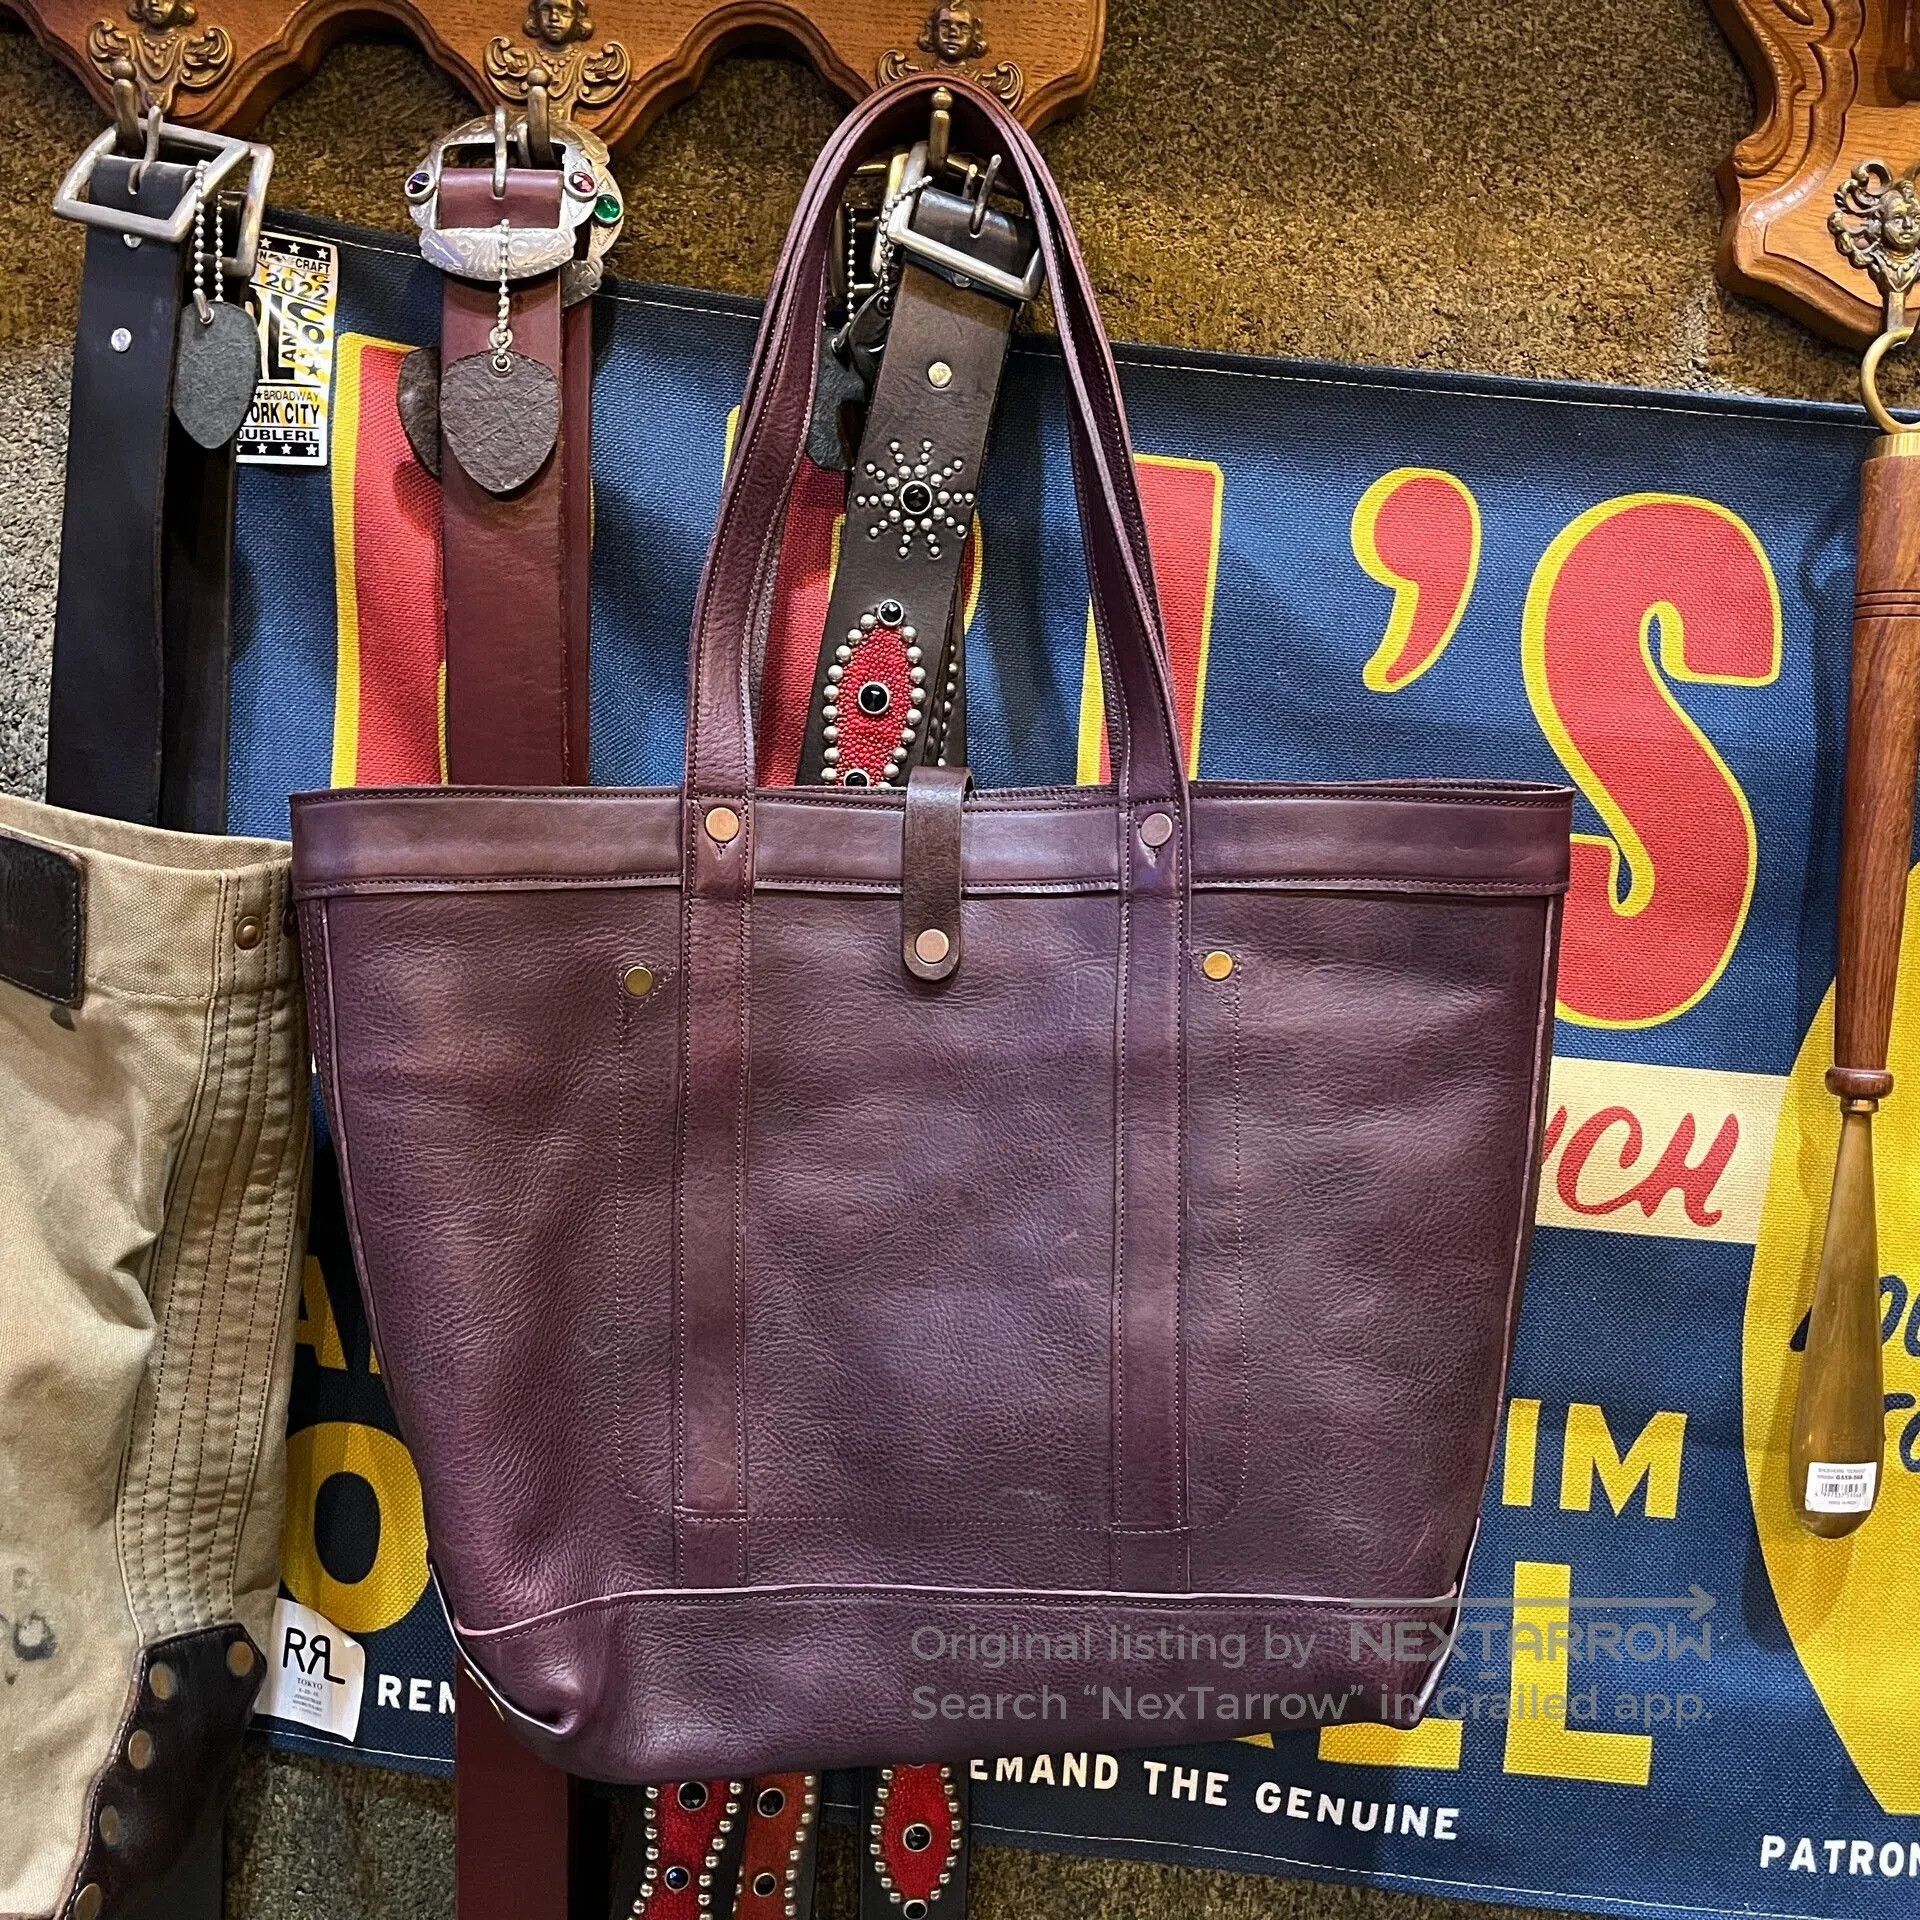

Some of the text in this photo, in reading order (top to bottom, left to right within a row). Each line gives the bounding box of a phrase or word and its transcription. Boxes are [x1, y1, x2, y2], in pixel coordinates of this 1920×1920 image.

[265, 271, 330, 304] 2022
[263, 389, 319, 402] BROADWAY
[284, 402, 320, 425] CITY
[297, 1677, 323, 1691] TOKYO
[1143, 1761, 1231, 1806] THE
[1255, 1781, 1459, 1840] GENUINE
